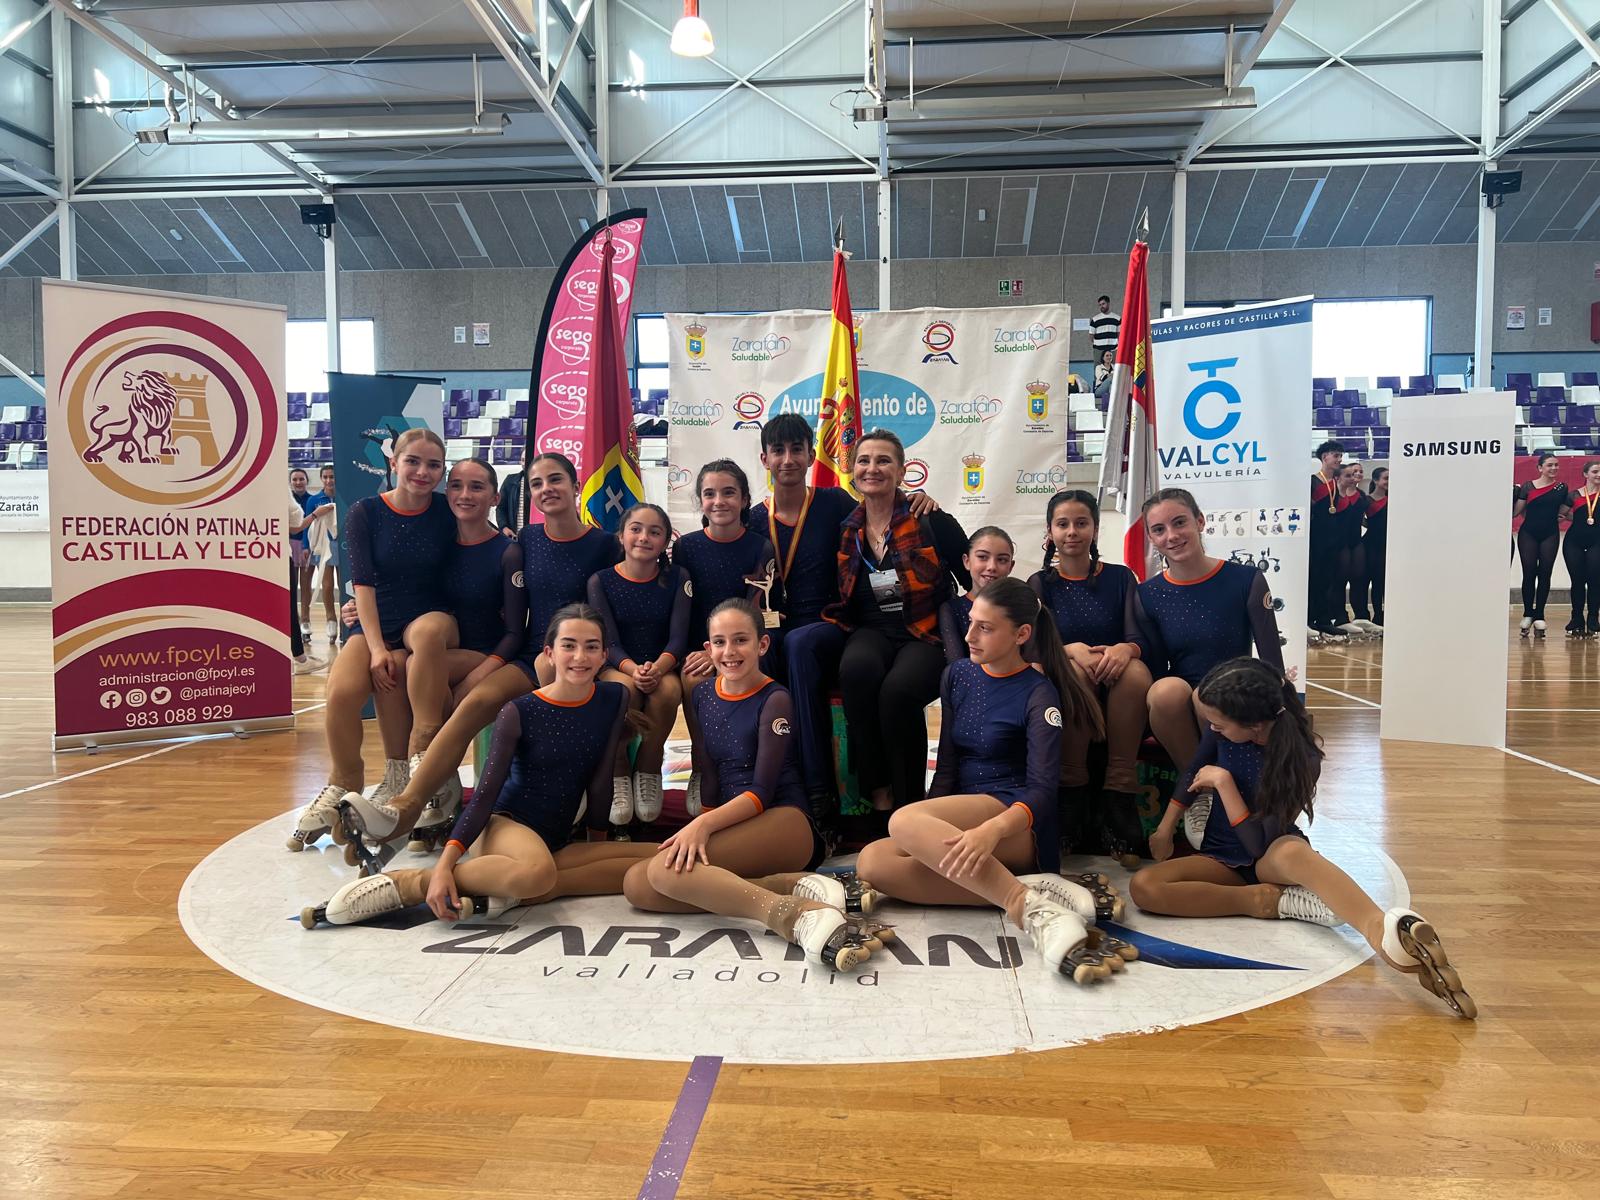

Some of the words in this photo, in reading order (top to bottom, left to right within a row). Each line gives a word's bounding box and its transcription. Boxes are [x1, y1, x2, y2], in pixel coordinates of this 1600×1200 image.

[1175, 326, 1182, 334] Y
[1184, 320, 1221, 332] RACORES
[1224, 317, 1236, 326] DE
[1238, 312, 1280, 324] CASTILLA
[994, 324, 1052, 343] Zaratán
[731, 334, 787, 352] Zaratán
[994, 343, 1035, 353] Saludable
[731, 352, 771, 361] Saludable
[671, 401, 720, 418] Zaratán
[905, 392, 927, 415] de
[940, 397, 997, 415] Zaratán
[671, 417, 710, 427] Saludable
[940, 415, 981, 425] Saludable
[1158, 441, 1267, 469] VALCYL
[1403, 440, 1501, 457] SAMSUNG
[1163, 467, 1262, 480] VALVULERÍA
[1015, 484, 1056, 494] Saludable
[0, 501, 39, 512] Zaratán
[62, 513, 189, 537] FEDERACIÓN
[196, 517, 280, 537] PATINAJE
[62, 541, 189, 562] CASTILLA
[195, 541, 211, 560] Y
[220, 537, 281, 560] LEÓN
[99, 643, 255, 668] www.fpcyl.es
[99, 666, 255, 686] administracion@fpcyl.es
[180, 682, 256, 701] @patinajecyl
[125, 711, 159, 728] 983
[164, 707, 197, 723] 088
[202, 704, 233, 721] 929
[543, 963, 879, 987] valladolid
